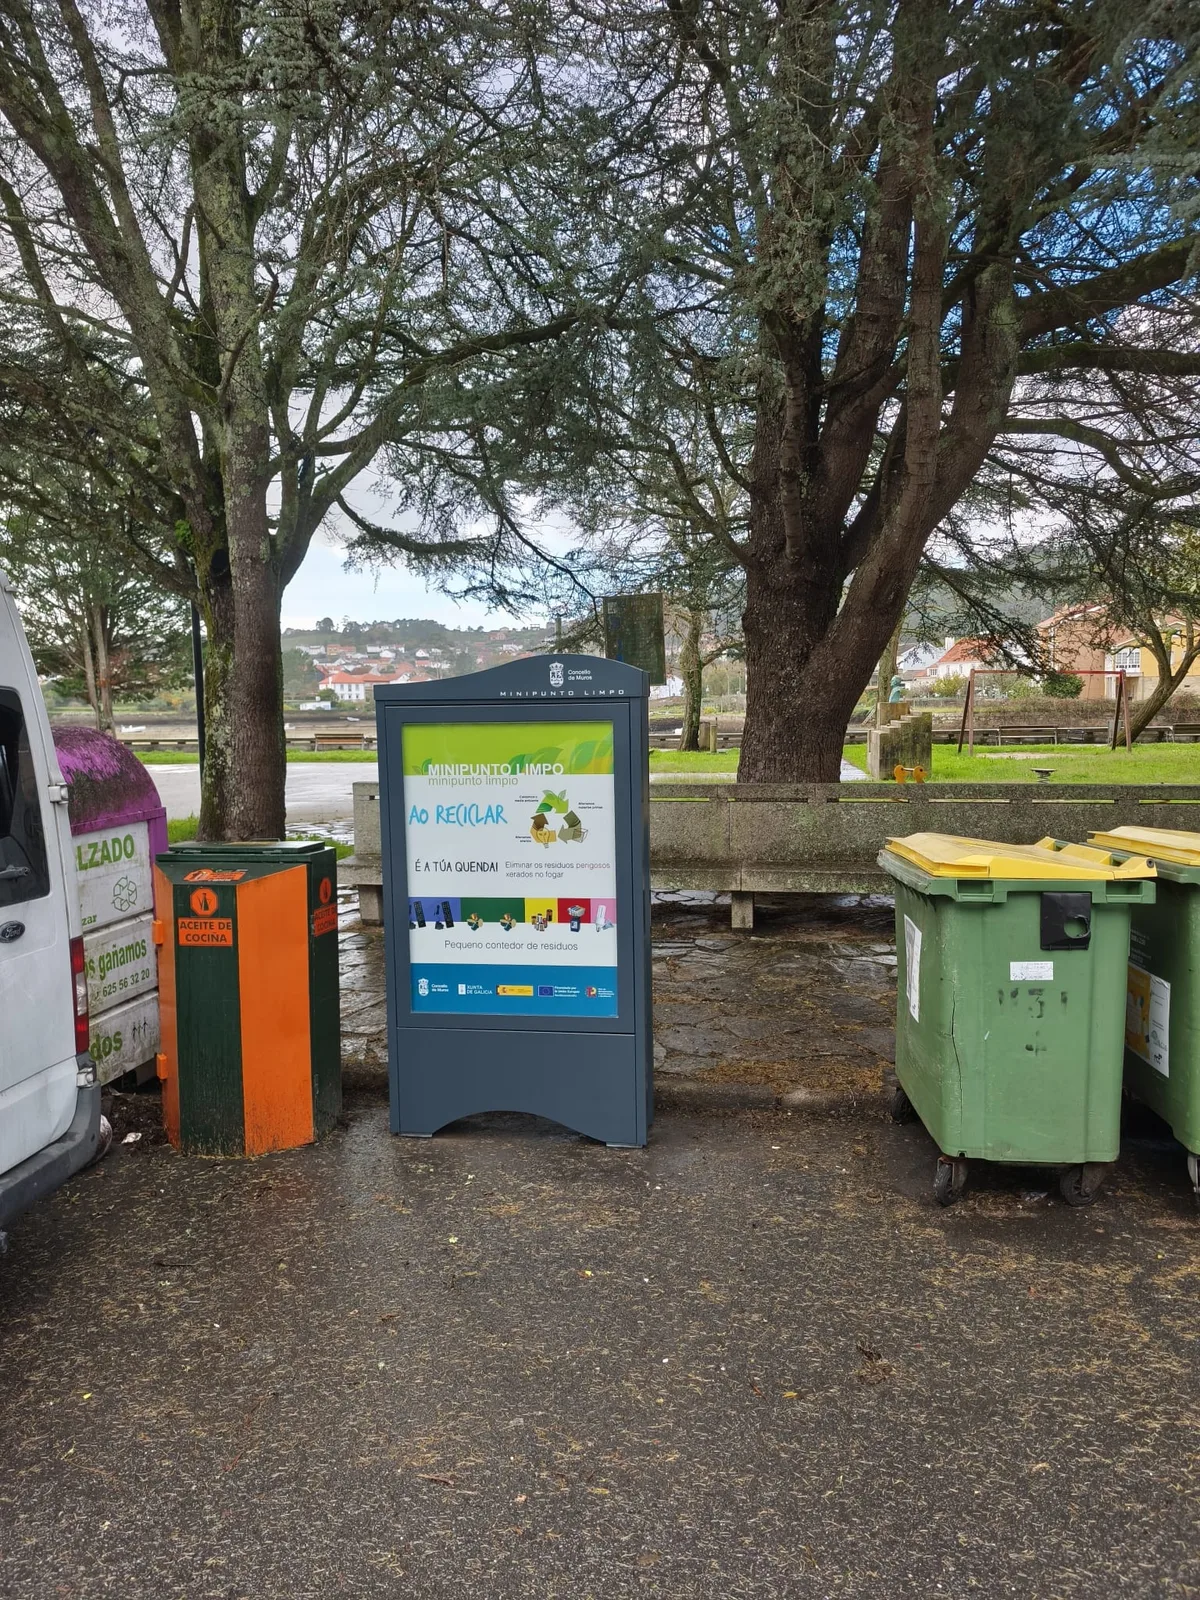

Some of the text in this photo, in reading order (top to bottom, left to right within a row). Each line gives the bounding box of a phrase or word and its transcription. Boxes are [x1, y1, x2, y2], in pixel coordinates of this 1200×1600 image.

[428, 763, 564, 776] MINIPUNTO LIMPO
[428, 775, 519, 788] minipunto limpio
[436, 803, 508, 827] RECICLAR
[76, 834, 135, 872] LZADO
[415, 858, 422, 872] É
[424, 861, 431, 872] A
[432, 858, 453, 872] TÚA
[505, 861, 533, 869] Eliminar
[545, 870, 564, 879] fogar
[82, 915, 97, 926] zar
[180, 921, 232, 931] ACEITE DE
[444, 940, 579, 951] Pequeno contedor de residuos
[98, 939, 147, 981] gañamos
[102, 982, 117, 998] 625
[119, 977, 129, 991] 56
[130, 972, 140, 986] 32
[141, 968, 150, 981] 20
[90, 1030, 123, 1062] dos
